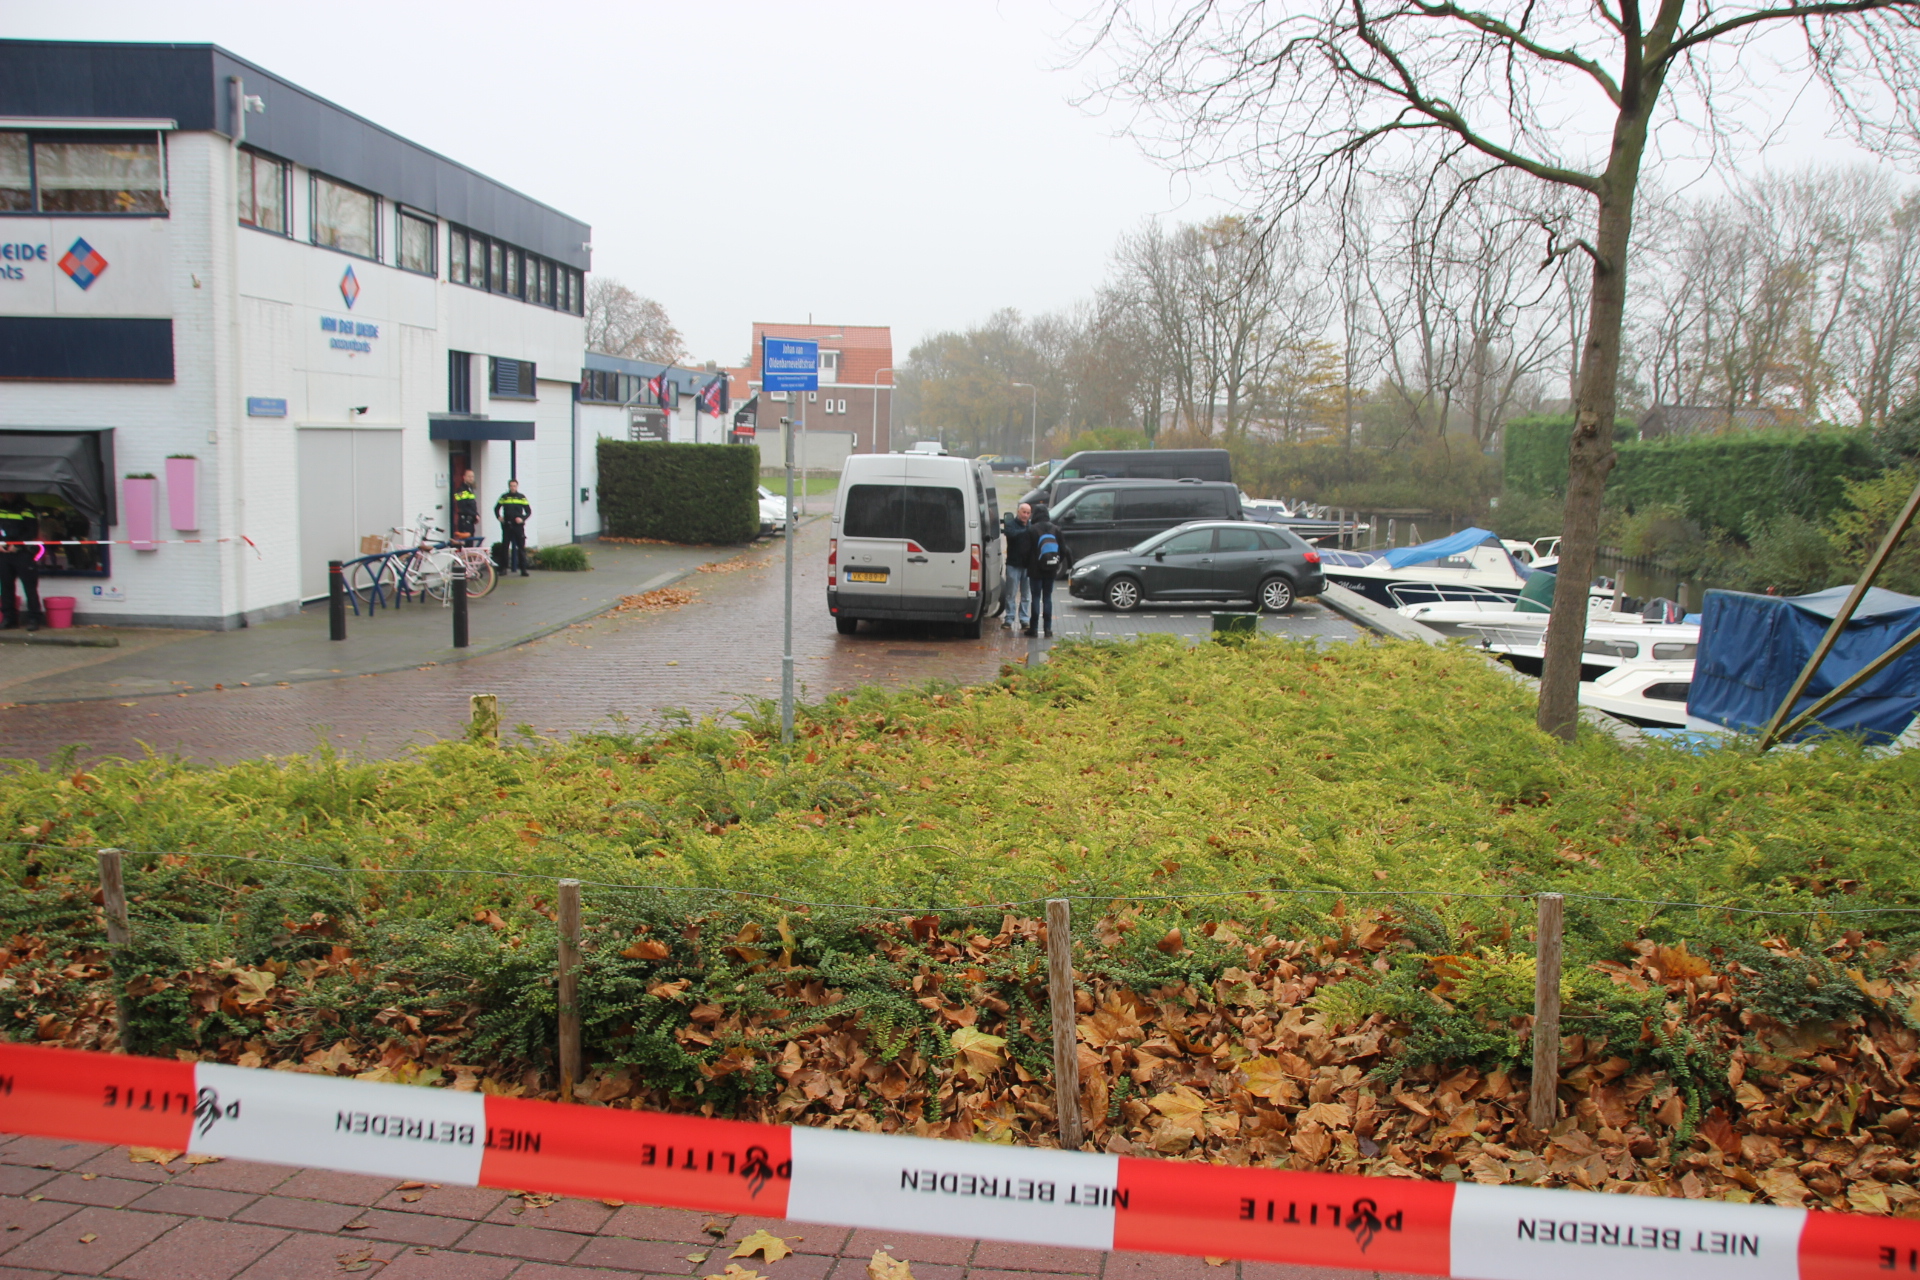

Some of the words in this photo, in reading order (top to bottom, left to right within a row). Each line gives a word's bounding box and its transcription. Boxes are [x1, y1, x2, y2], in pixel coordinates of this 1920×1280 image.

[0, 243, 47, 260] EIDE
[782, 343, 795, 354] Johan
[795, 346, 803, 354] van
[336, 1111, 475, 1146] BETREDEN
[483, 1127, 542, 1154] NIET
[900, 1169, 1056, 1203] BETREDEN
[1065, 1184, 1130, 1210] NIET
[1517, 1218, 1681, 1251] BETREDEN
[1690, 1230, 1759, 1257] NIET
